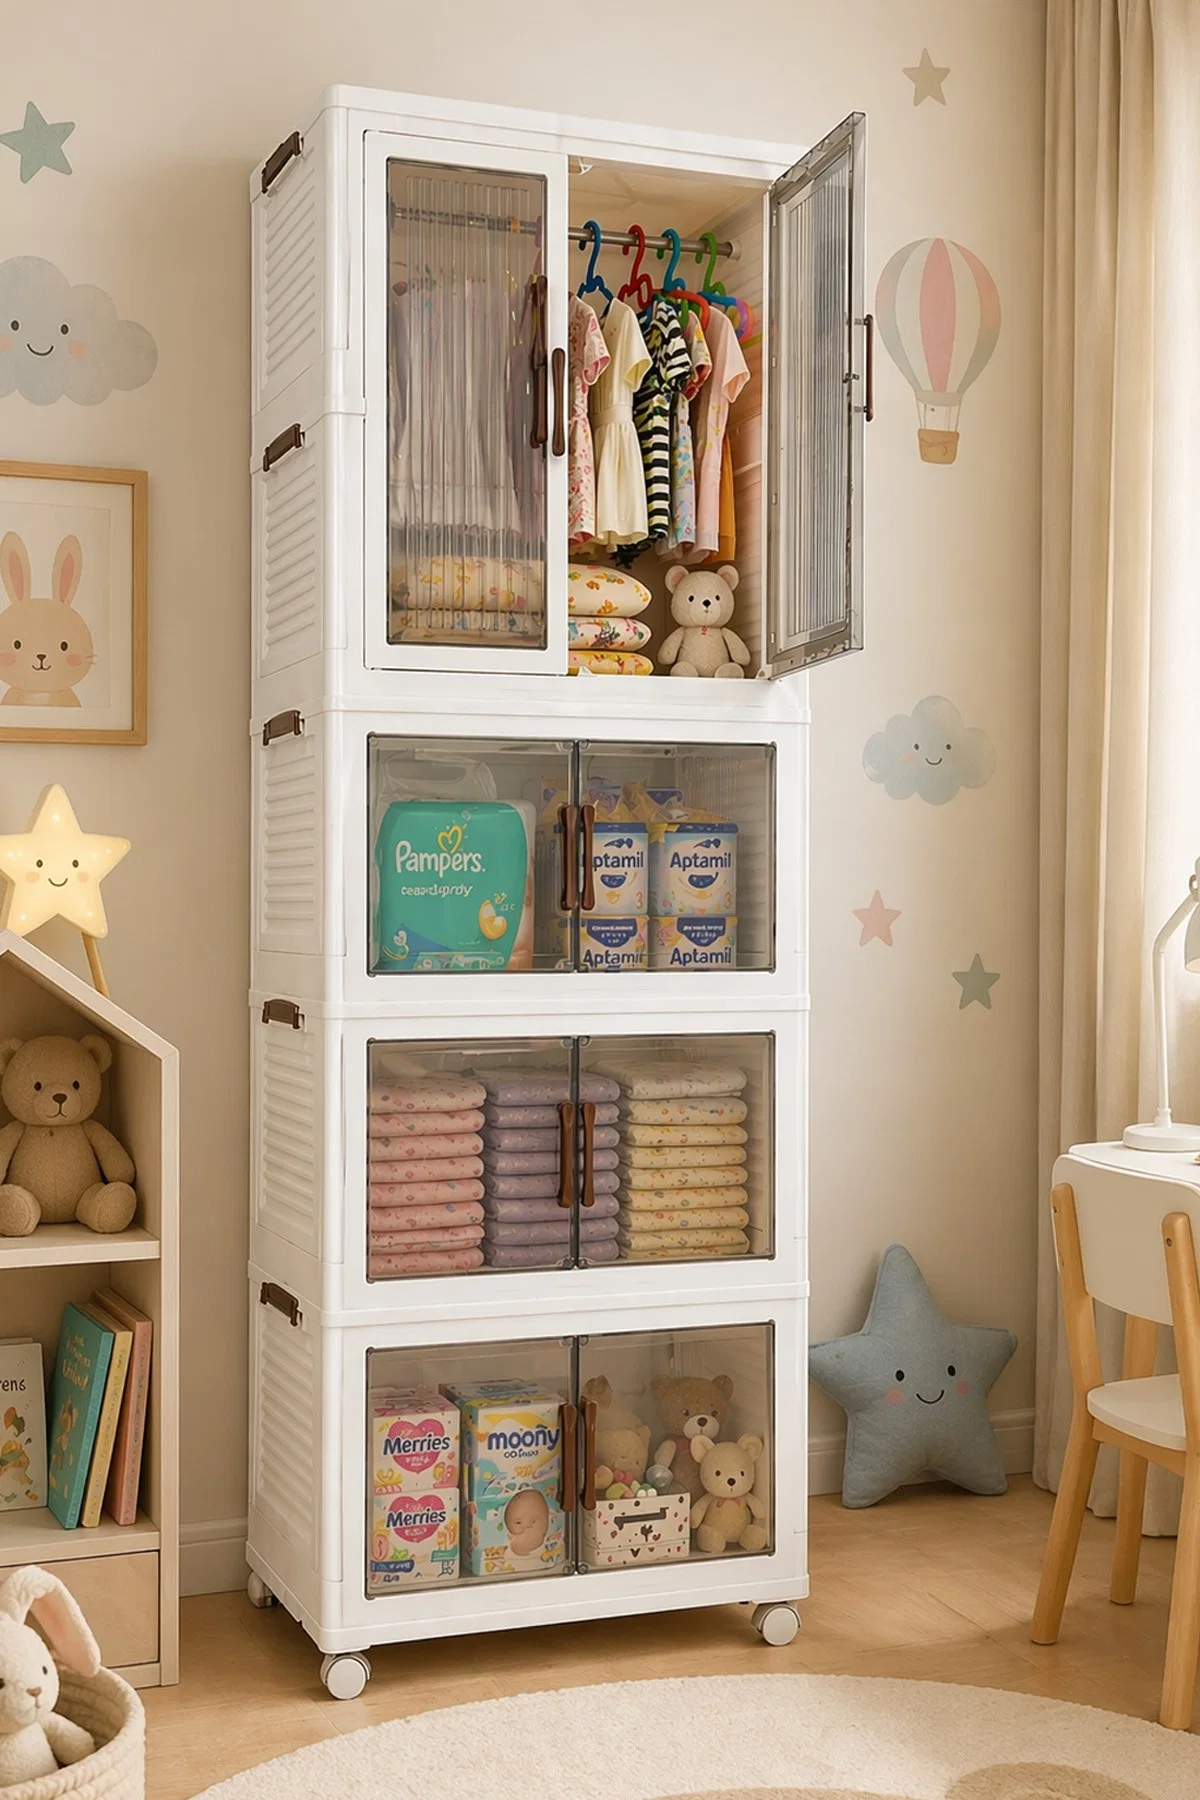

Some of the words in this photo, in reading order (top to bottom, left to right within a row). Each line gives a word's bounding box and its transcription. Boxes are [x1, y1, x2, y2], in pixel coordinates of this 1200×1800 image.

[591, 851, 644, 871] ptamil
[670, 852, 731, 872] Aptamil
[583, 948, 643, 968] Aptamil
[670, 947, 732, 966] Aptamil
[0, 1379, 26, 1392] ens
[383, 1434, 450, 1455] Merries
[386, 1508, 446, 1528] Merries
